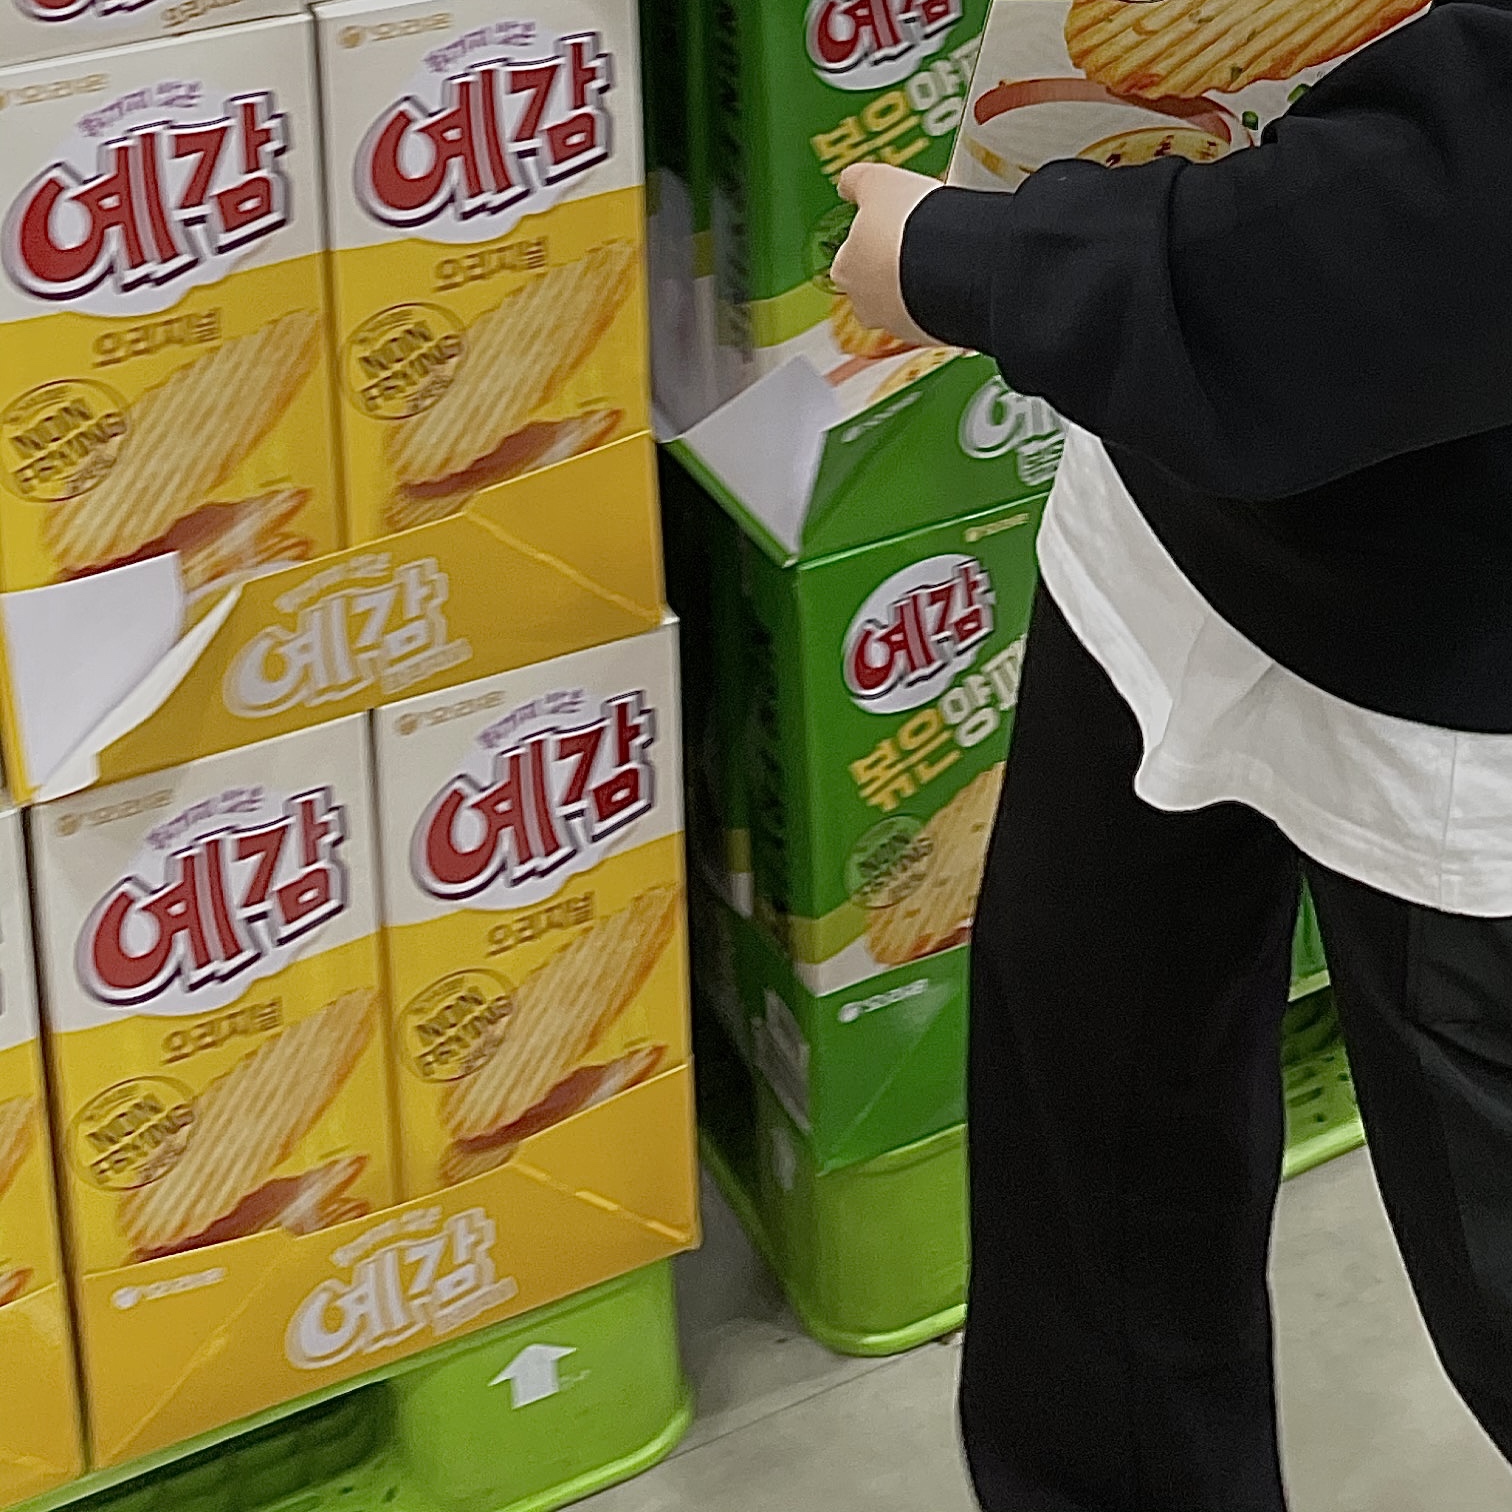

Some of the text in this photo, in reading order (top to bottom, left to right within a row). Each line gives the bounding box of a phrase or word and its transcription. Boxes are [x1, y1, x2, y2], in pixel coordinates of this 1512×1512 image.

[2, 90, 290, 302] 예감
[354, 30, 614, 229] 예감
[91, 308, 223, 370] 오리지널
[431, 235, 549, 294] 오리지널
[224, 556, 450, 719] 예감
[846, 554, 997, 701] 예감
[409, 688, 656, 902] 예감
[74, 785, 350, 1008] 예감
[285, 1205, 500, 1370] 예감
